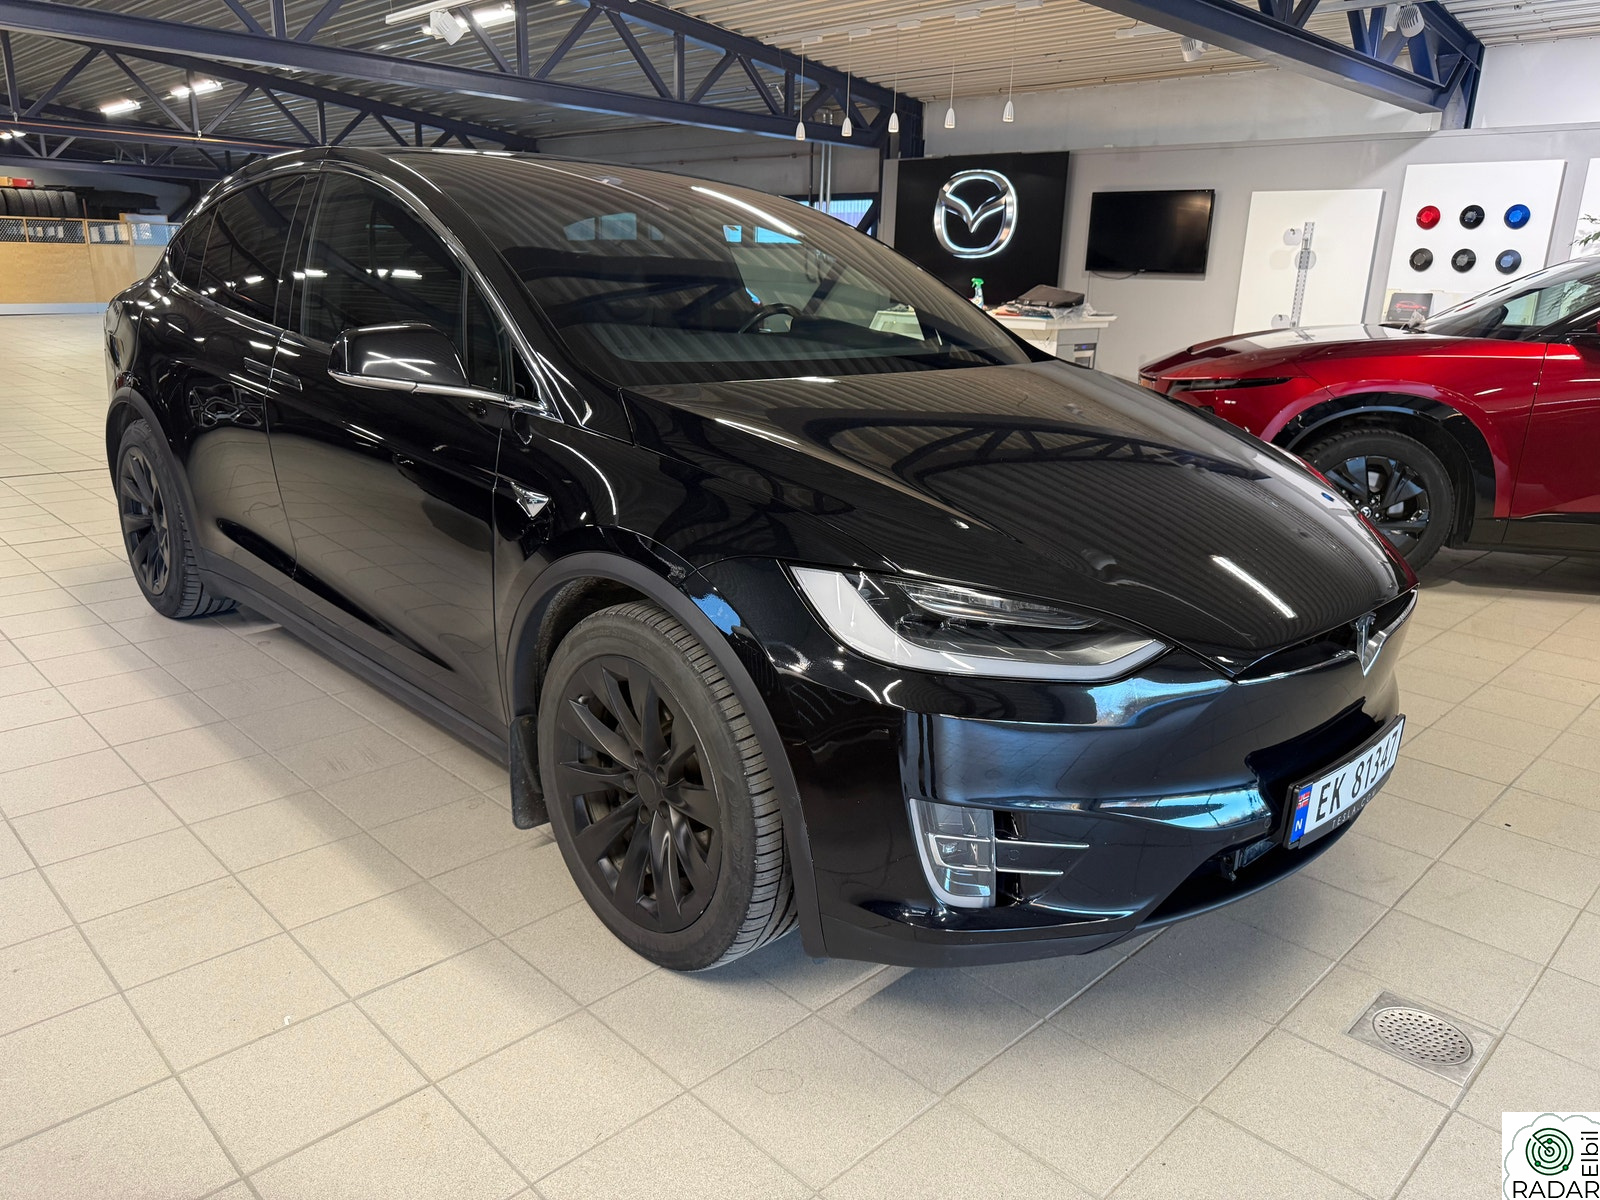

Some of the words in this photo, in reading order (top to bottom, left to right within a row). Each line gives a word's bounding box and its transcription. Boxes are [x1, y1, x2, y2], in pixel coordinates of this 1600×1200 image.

[1314, 773, 1346, 823] EK
[1351, 731, 1398, 799] 81347
[1294, 818, 1304, 831] N
